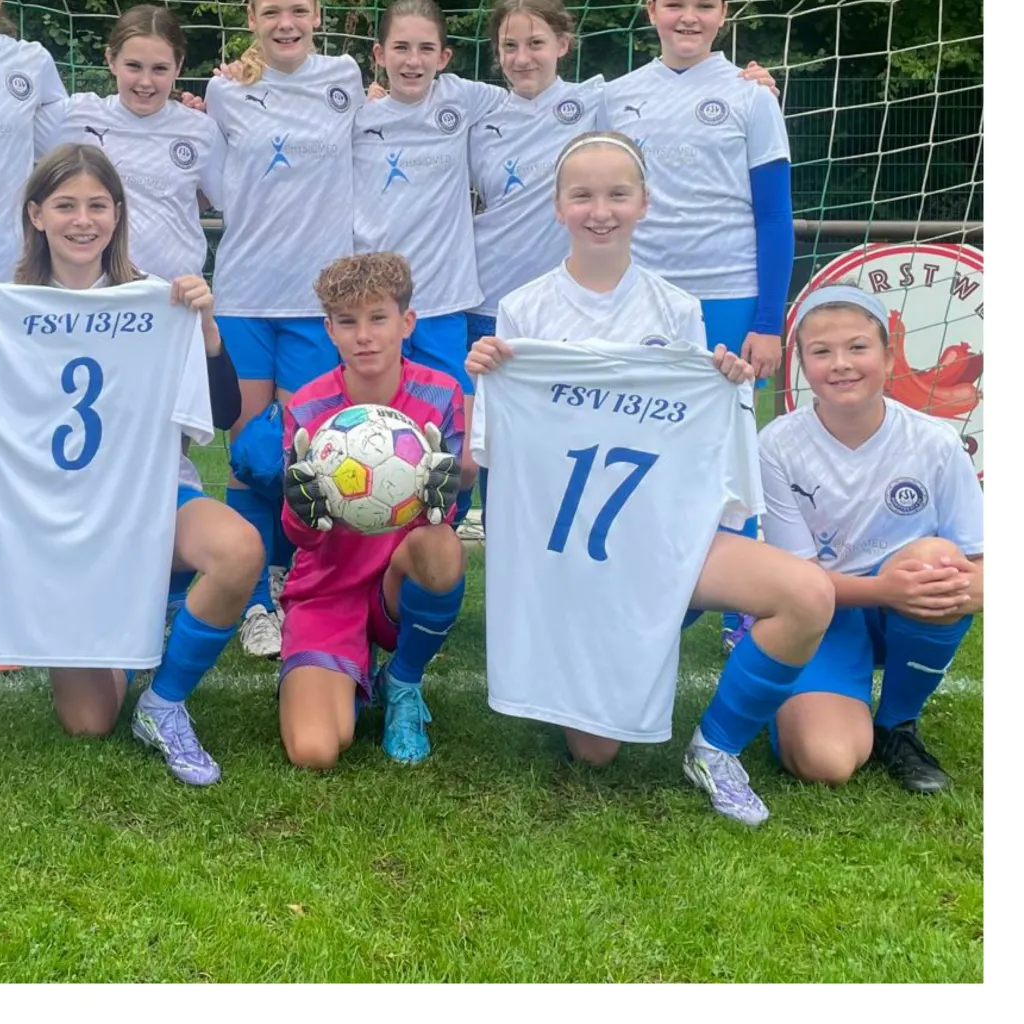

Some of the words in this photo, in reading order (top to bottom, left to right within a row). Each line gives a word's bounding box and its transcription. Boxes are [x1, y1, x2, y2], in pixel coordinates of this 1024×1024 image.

[856, 262, 984, 321] RSTW
[23, 312, 80, 336] FSV
[85, 311, 154, 339] 13/23
[51, 356, 104, 471] 3
[551, 383, 610, 410] FSV
[612, 393, 688, 424] 13/23
[547, 443, 661, 562] 17
